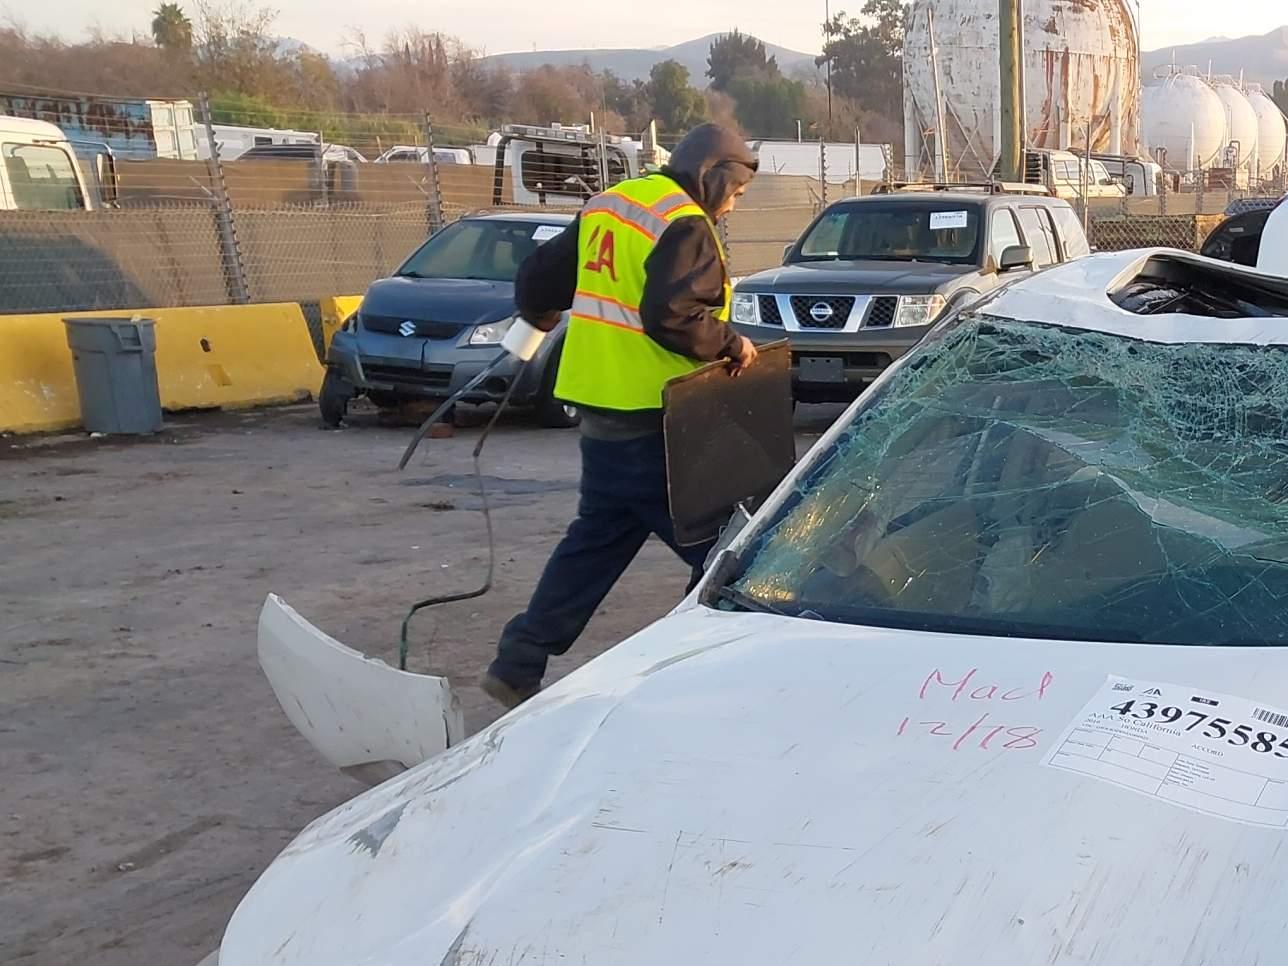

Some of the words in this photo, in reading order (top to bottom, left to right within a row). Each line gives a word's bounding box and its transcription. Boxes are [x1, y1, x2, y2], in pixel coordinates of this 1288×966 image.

[1088, 712, 1114, 721] AAA
[1118, 714, 1131, 723] So
[1132, 718, 1182, 737] California
